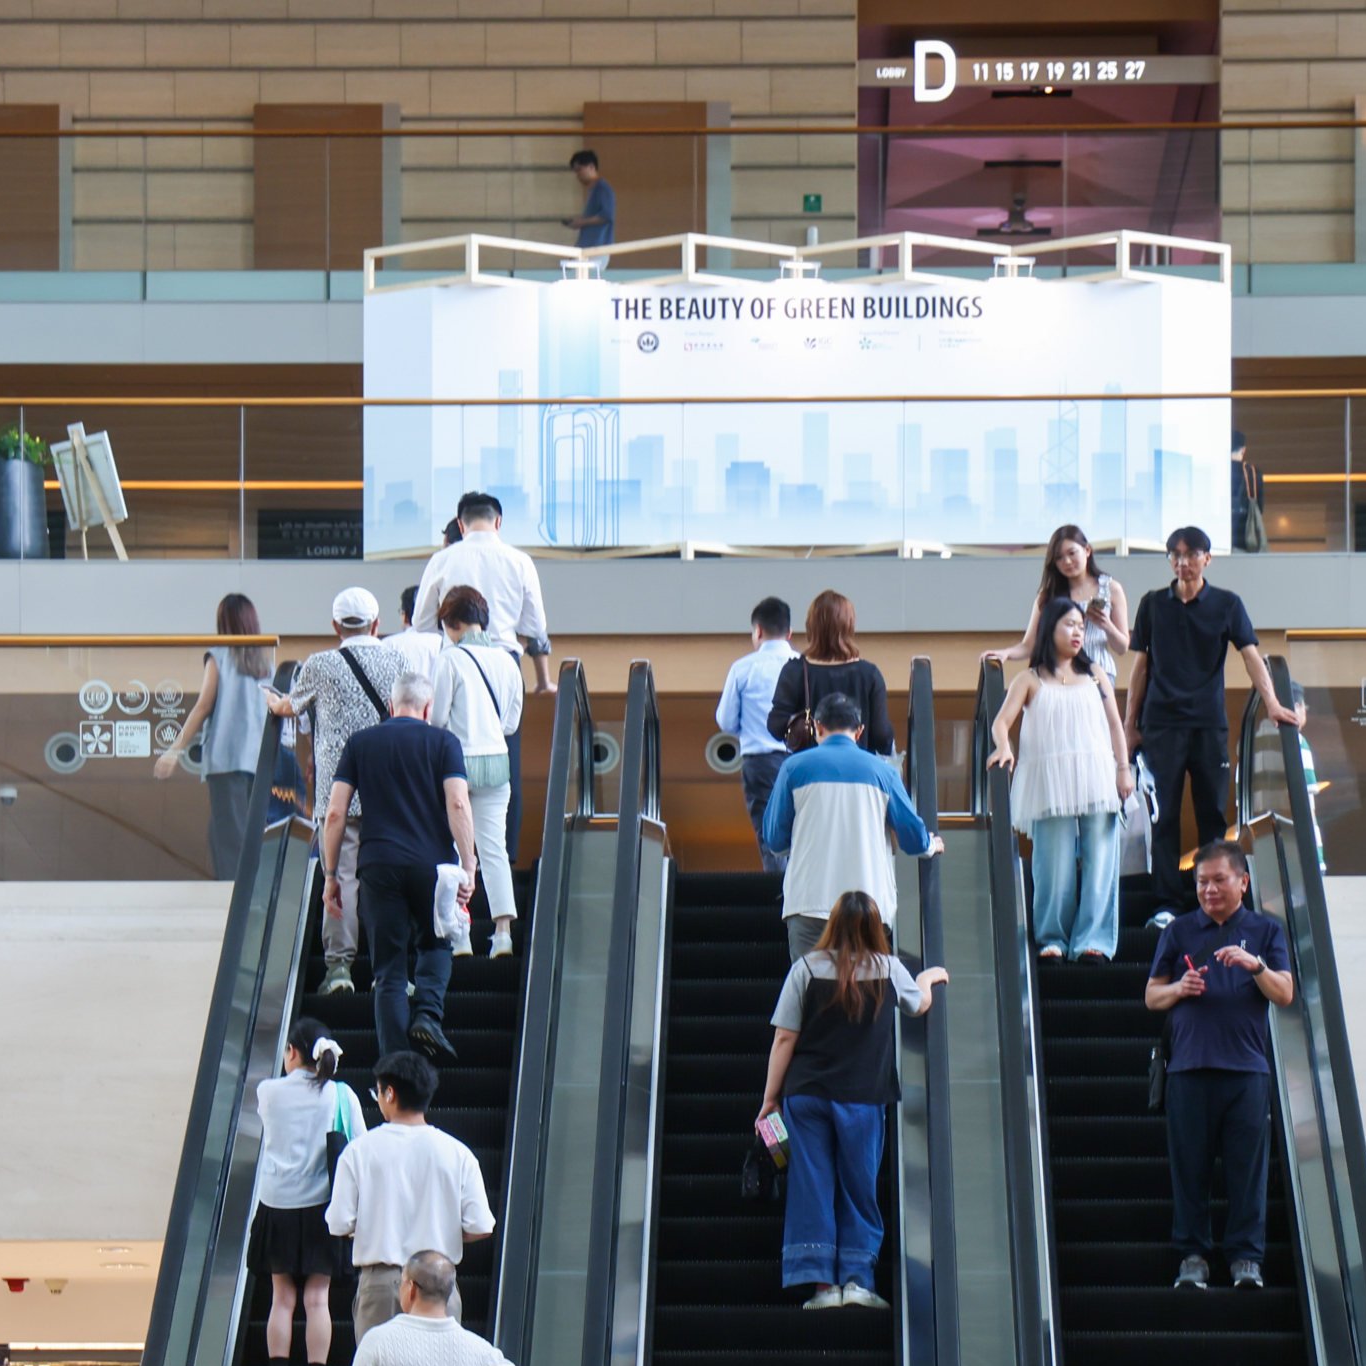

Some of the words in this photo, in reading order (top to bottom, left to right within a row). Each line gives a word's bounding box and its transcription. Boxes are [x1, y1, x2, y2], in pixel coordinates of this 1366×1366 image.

[876, 67, 906, 78] LOBBY
[914, 40, 956, 102] D
[973, 63, 988, 81] 11
[995, 62, 1014, 81] 15
[1021, 62, 1040, 81] 17
[1046, 62, 1065, 81] 19
[1072, 61, 1090, 80] 21
[1097, 61, 1117, 80] 25
[1125, 61, 1146, 80] 27
[611, 298, 653, 320] THE
[659, 298, 744, 320] BEAUTY
[750, 298, 776, 320] OF
[784, 297, 855, 320] GREEN
[862, 297, 983, 320] BUILDINGS
[307, 546, 346, 556] LOBBY
